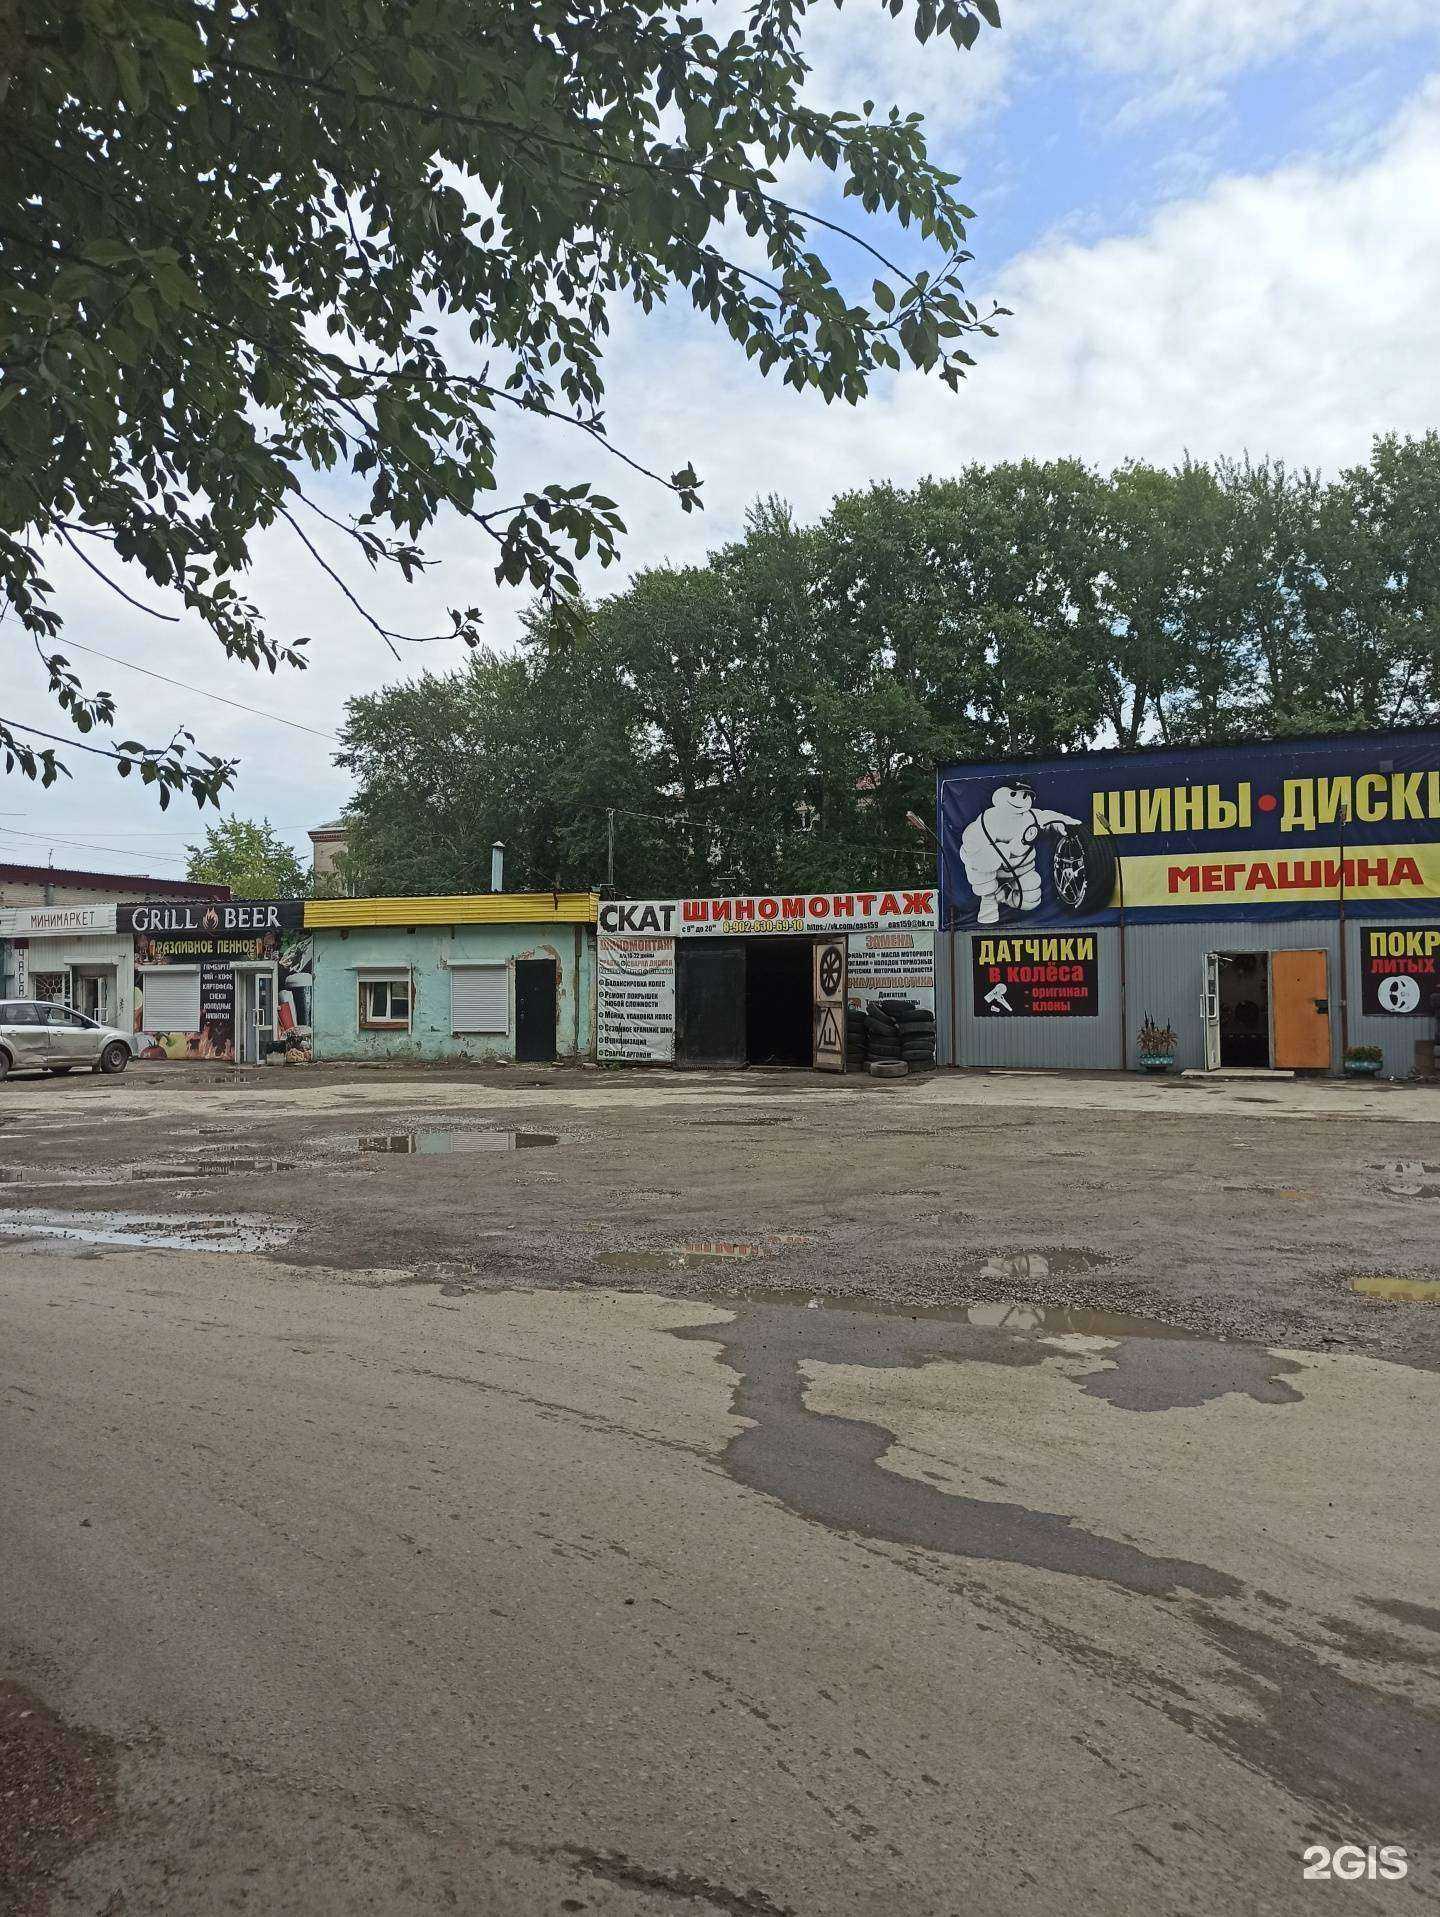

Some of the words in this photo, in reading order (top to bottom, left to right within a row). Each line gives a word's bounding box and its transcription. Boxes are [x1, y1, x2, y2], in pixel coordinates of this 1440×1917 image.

[1092, 781, 1251, 836] ШИНЫ
[1167, 856, 1425, 894] МЕГАШИНА
[600, 903, 676, 933] СКАТ
[682, 892, 934, 922] ШИНОМОНТАЖ
[30, 911, 96, 929] МИНИМАРКЕТ
[131, 906, 199, 932] GRILL
[223, 905, 282, 929] BEER
[722, 919, 804, 934] 8-902-830-69-10
[157, 940, 214, 955] РАЗЛИВНОЕ
[217, 940, 256, 955] ПЕННОЕ
[865, 934, 914, 949] ЗАМЕНА
[978, 938, 1094, 965] ДАТЧИКИ
[1006, 961, 1084, 983] колёса
[1032, 987, 1089, 999] оригинал
[1032, 1001, 1071, 1012] клоны
